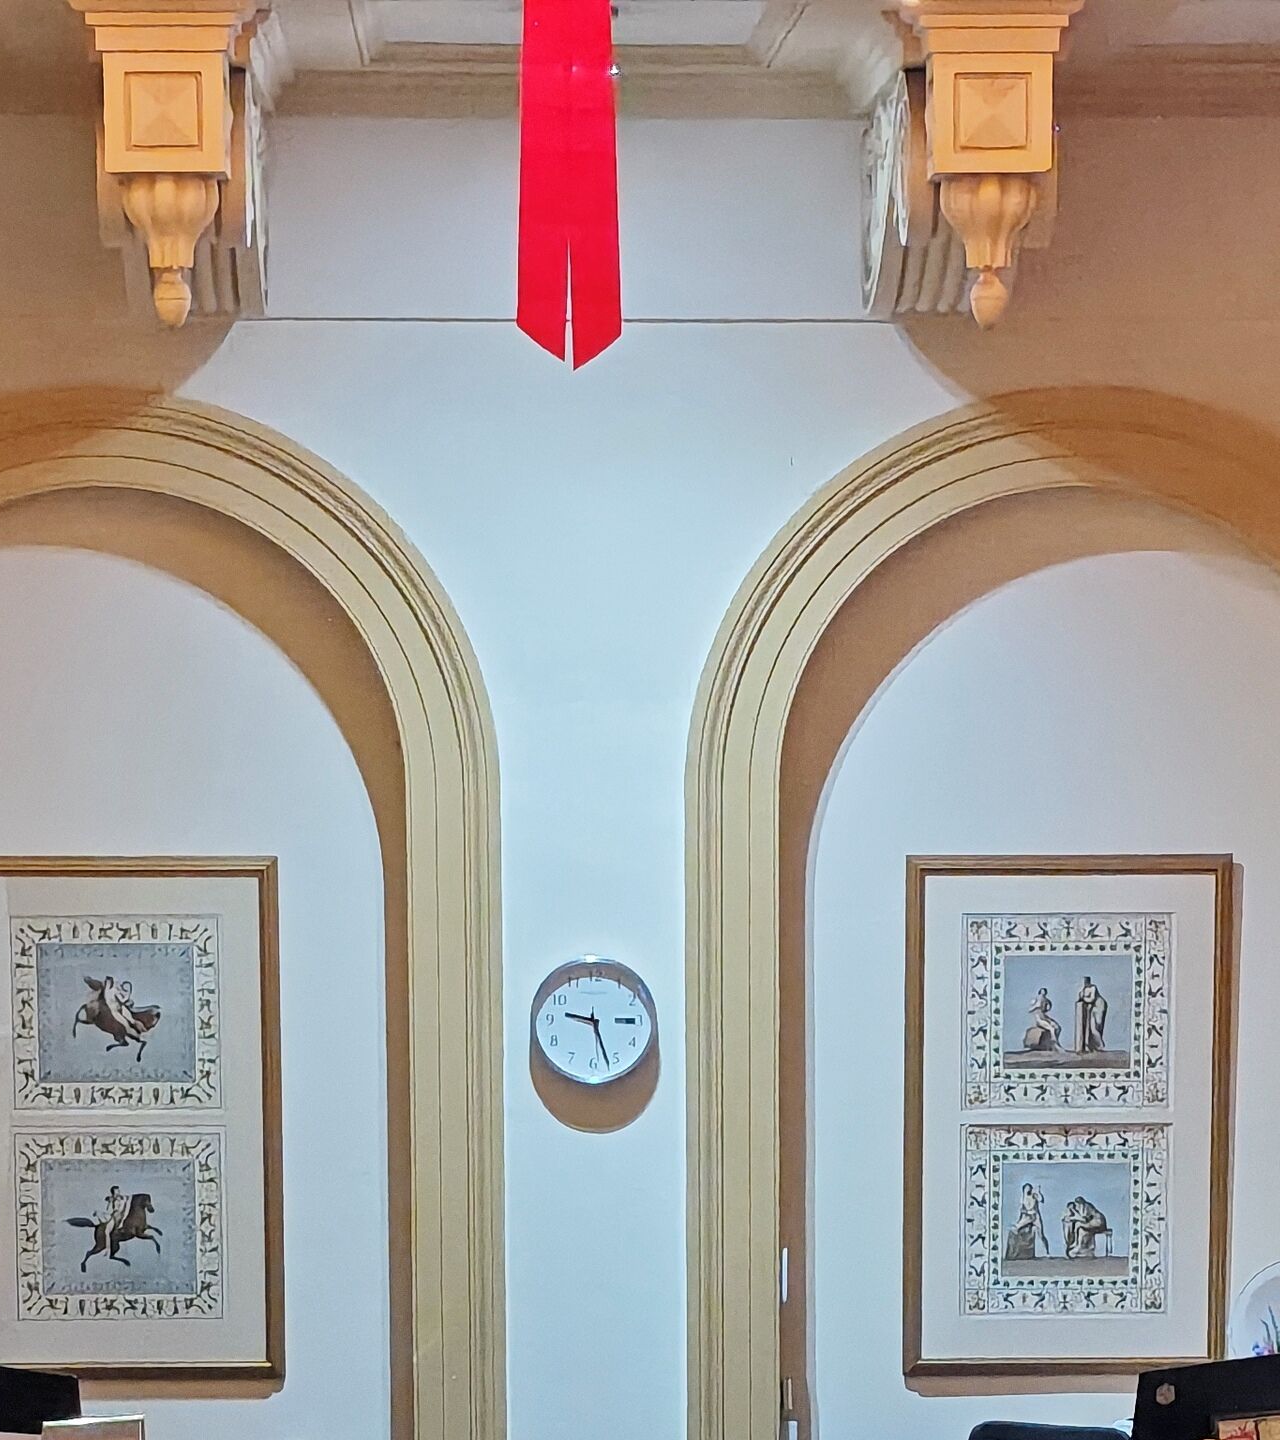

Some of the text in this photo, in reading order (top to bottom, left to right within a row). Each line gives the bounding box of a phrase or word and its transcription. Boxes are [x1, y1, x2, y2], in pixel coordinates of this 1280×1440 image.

[568, 975, 580, 989] 11
[588, 970, 605, 982] 12
[553, 994, 567, 1005] 10
[629, 993, 636, 1006] 2
[546, 1014, 555, 1026] 9
[635, 1014, 643, 1026] 3
[550, 1035, 558, 1047] 8
[628, 1035, 636, 1048] 4
[567, 1051, 576, 1064] 7
[612, 1052, 622, 1064] 5
[589, 1058, 598, 1070] 6
